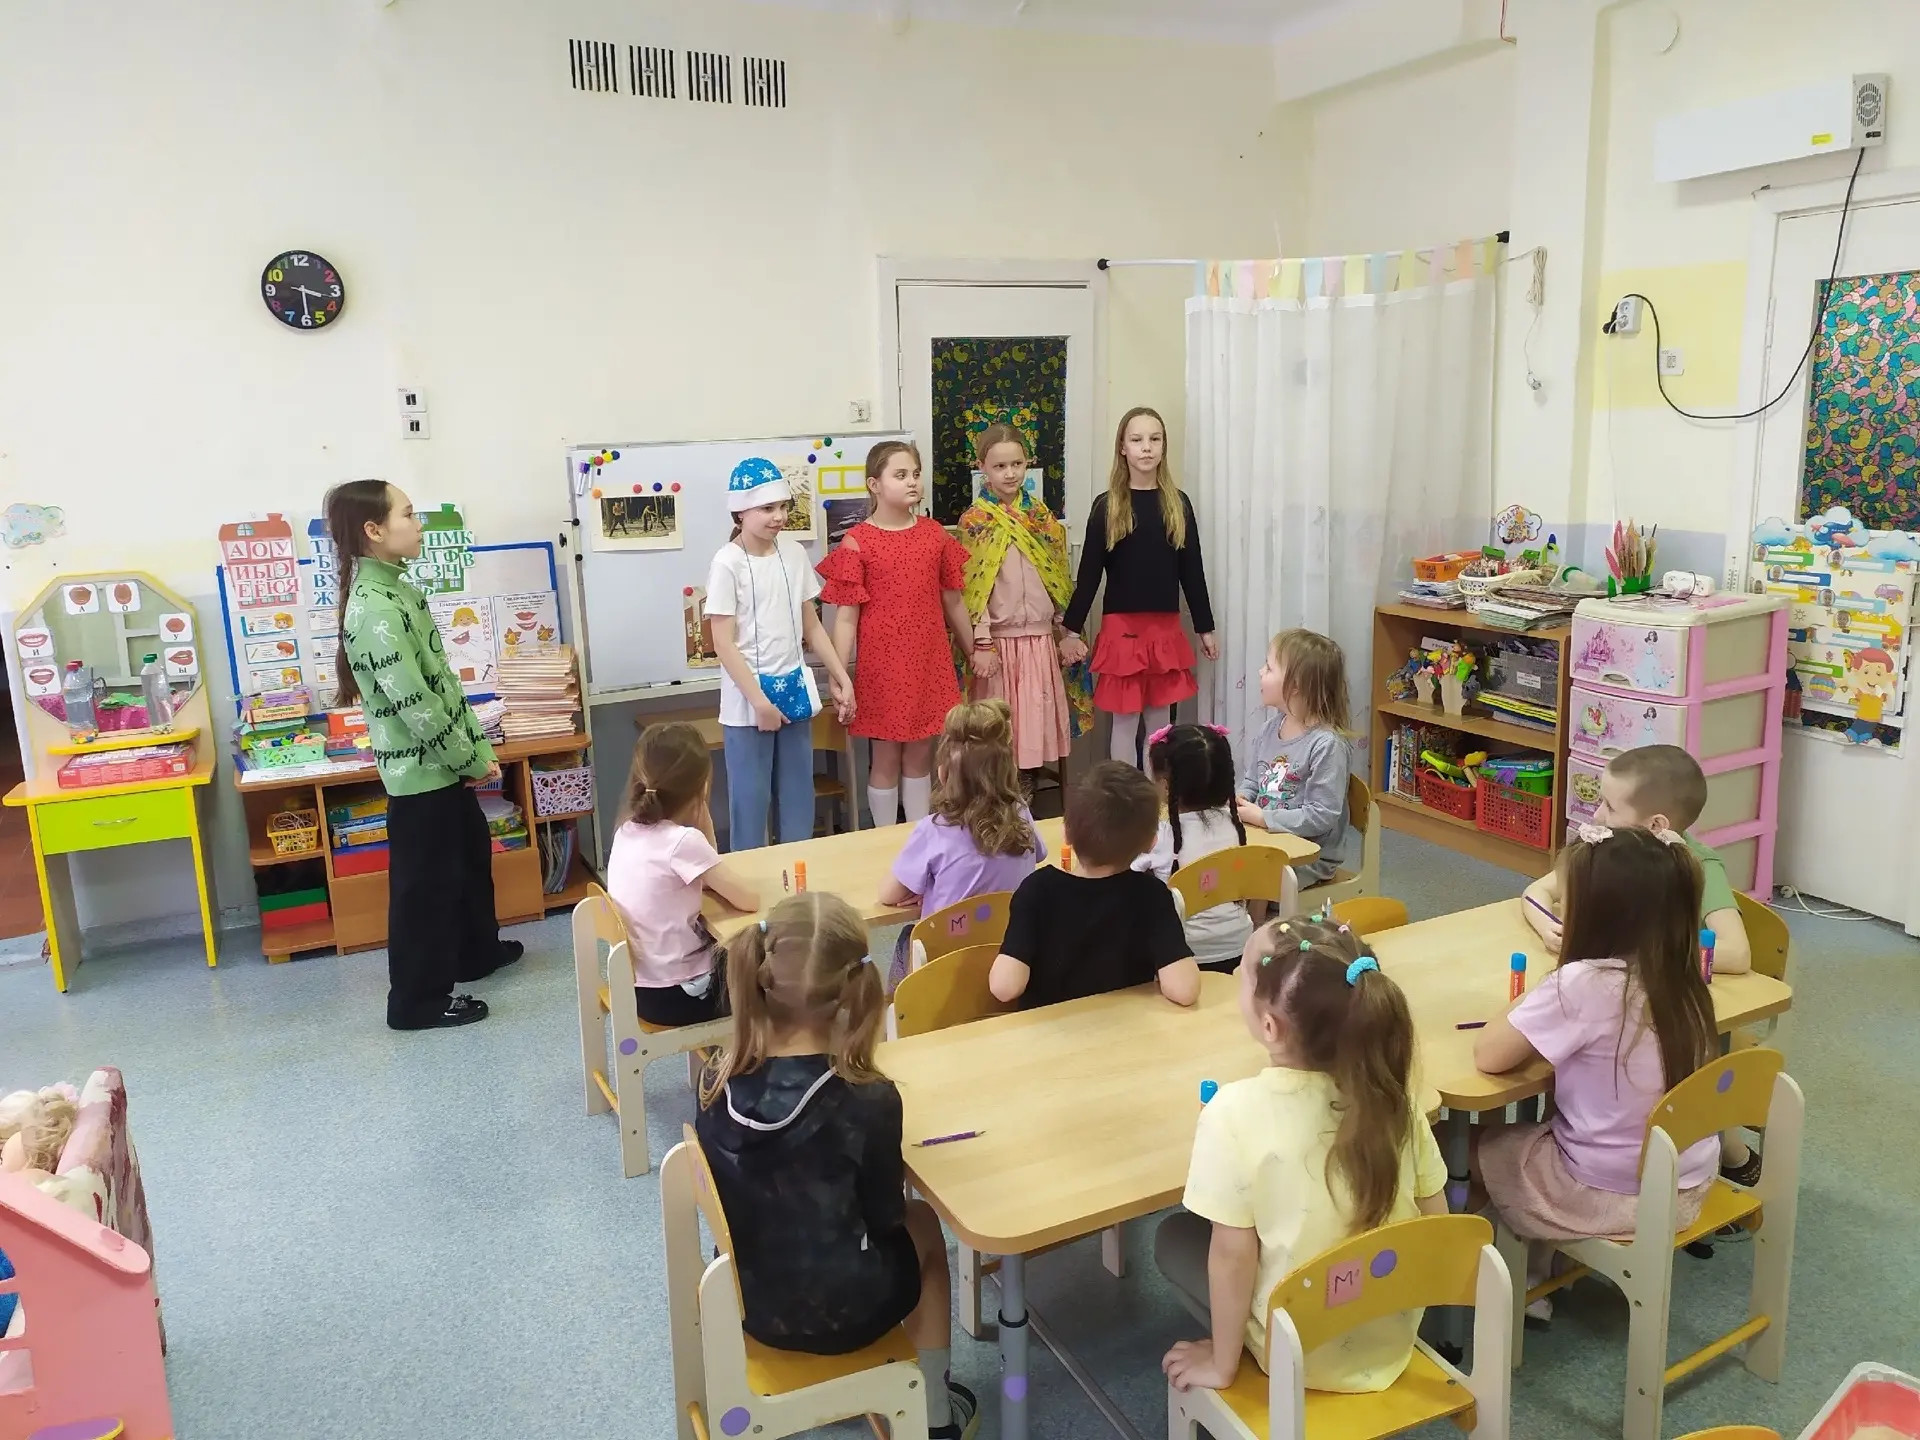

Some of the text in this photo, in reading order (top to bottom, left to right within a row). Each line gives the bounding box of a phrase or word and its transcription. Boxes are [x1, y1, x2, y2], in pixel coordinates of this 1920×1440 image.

[290, 254, 310, 267] 12
[267, 268, 283, 282] 10
[324, 269, 336, 283] 2
[265, 283, 276, 297] 9
[330, 284, 341, 297] 3
[327, 300, 337, 311] 4
[284, 310, 295, 323] 7
[301, 314, 312, 327] 6
[314, 310, 326, 324] 5
